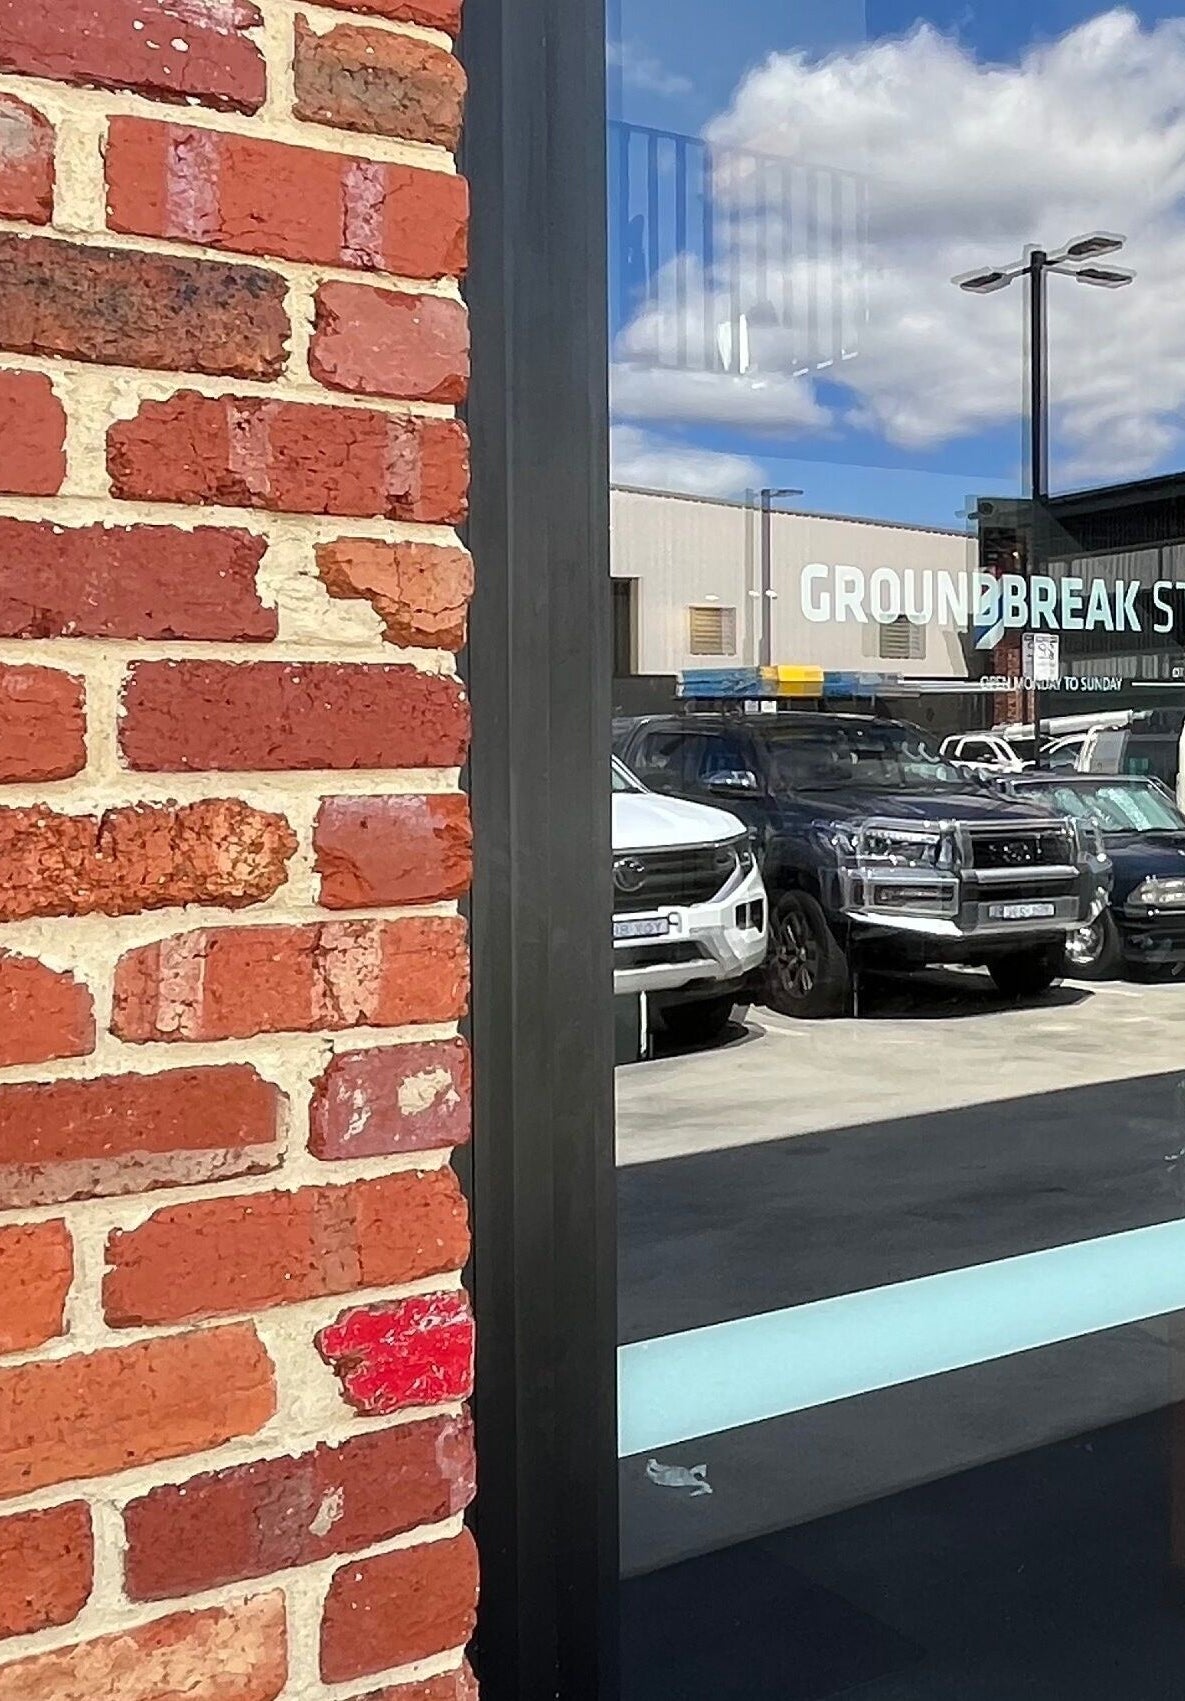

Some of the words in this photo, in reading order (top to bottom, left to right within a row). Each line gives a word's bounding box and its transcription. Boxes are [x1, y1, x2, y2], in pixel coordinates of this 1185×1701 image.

[800, 562, 1142, 634] GROUNDBREAK
[1013, 676, 1062, 691] MONDAY
[1064, 676, 1079, 691] TO
[1080, 676, 1123, 691] SUNDAY
